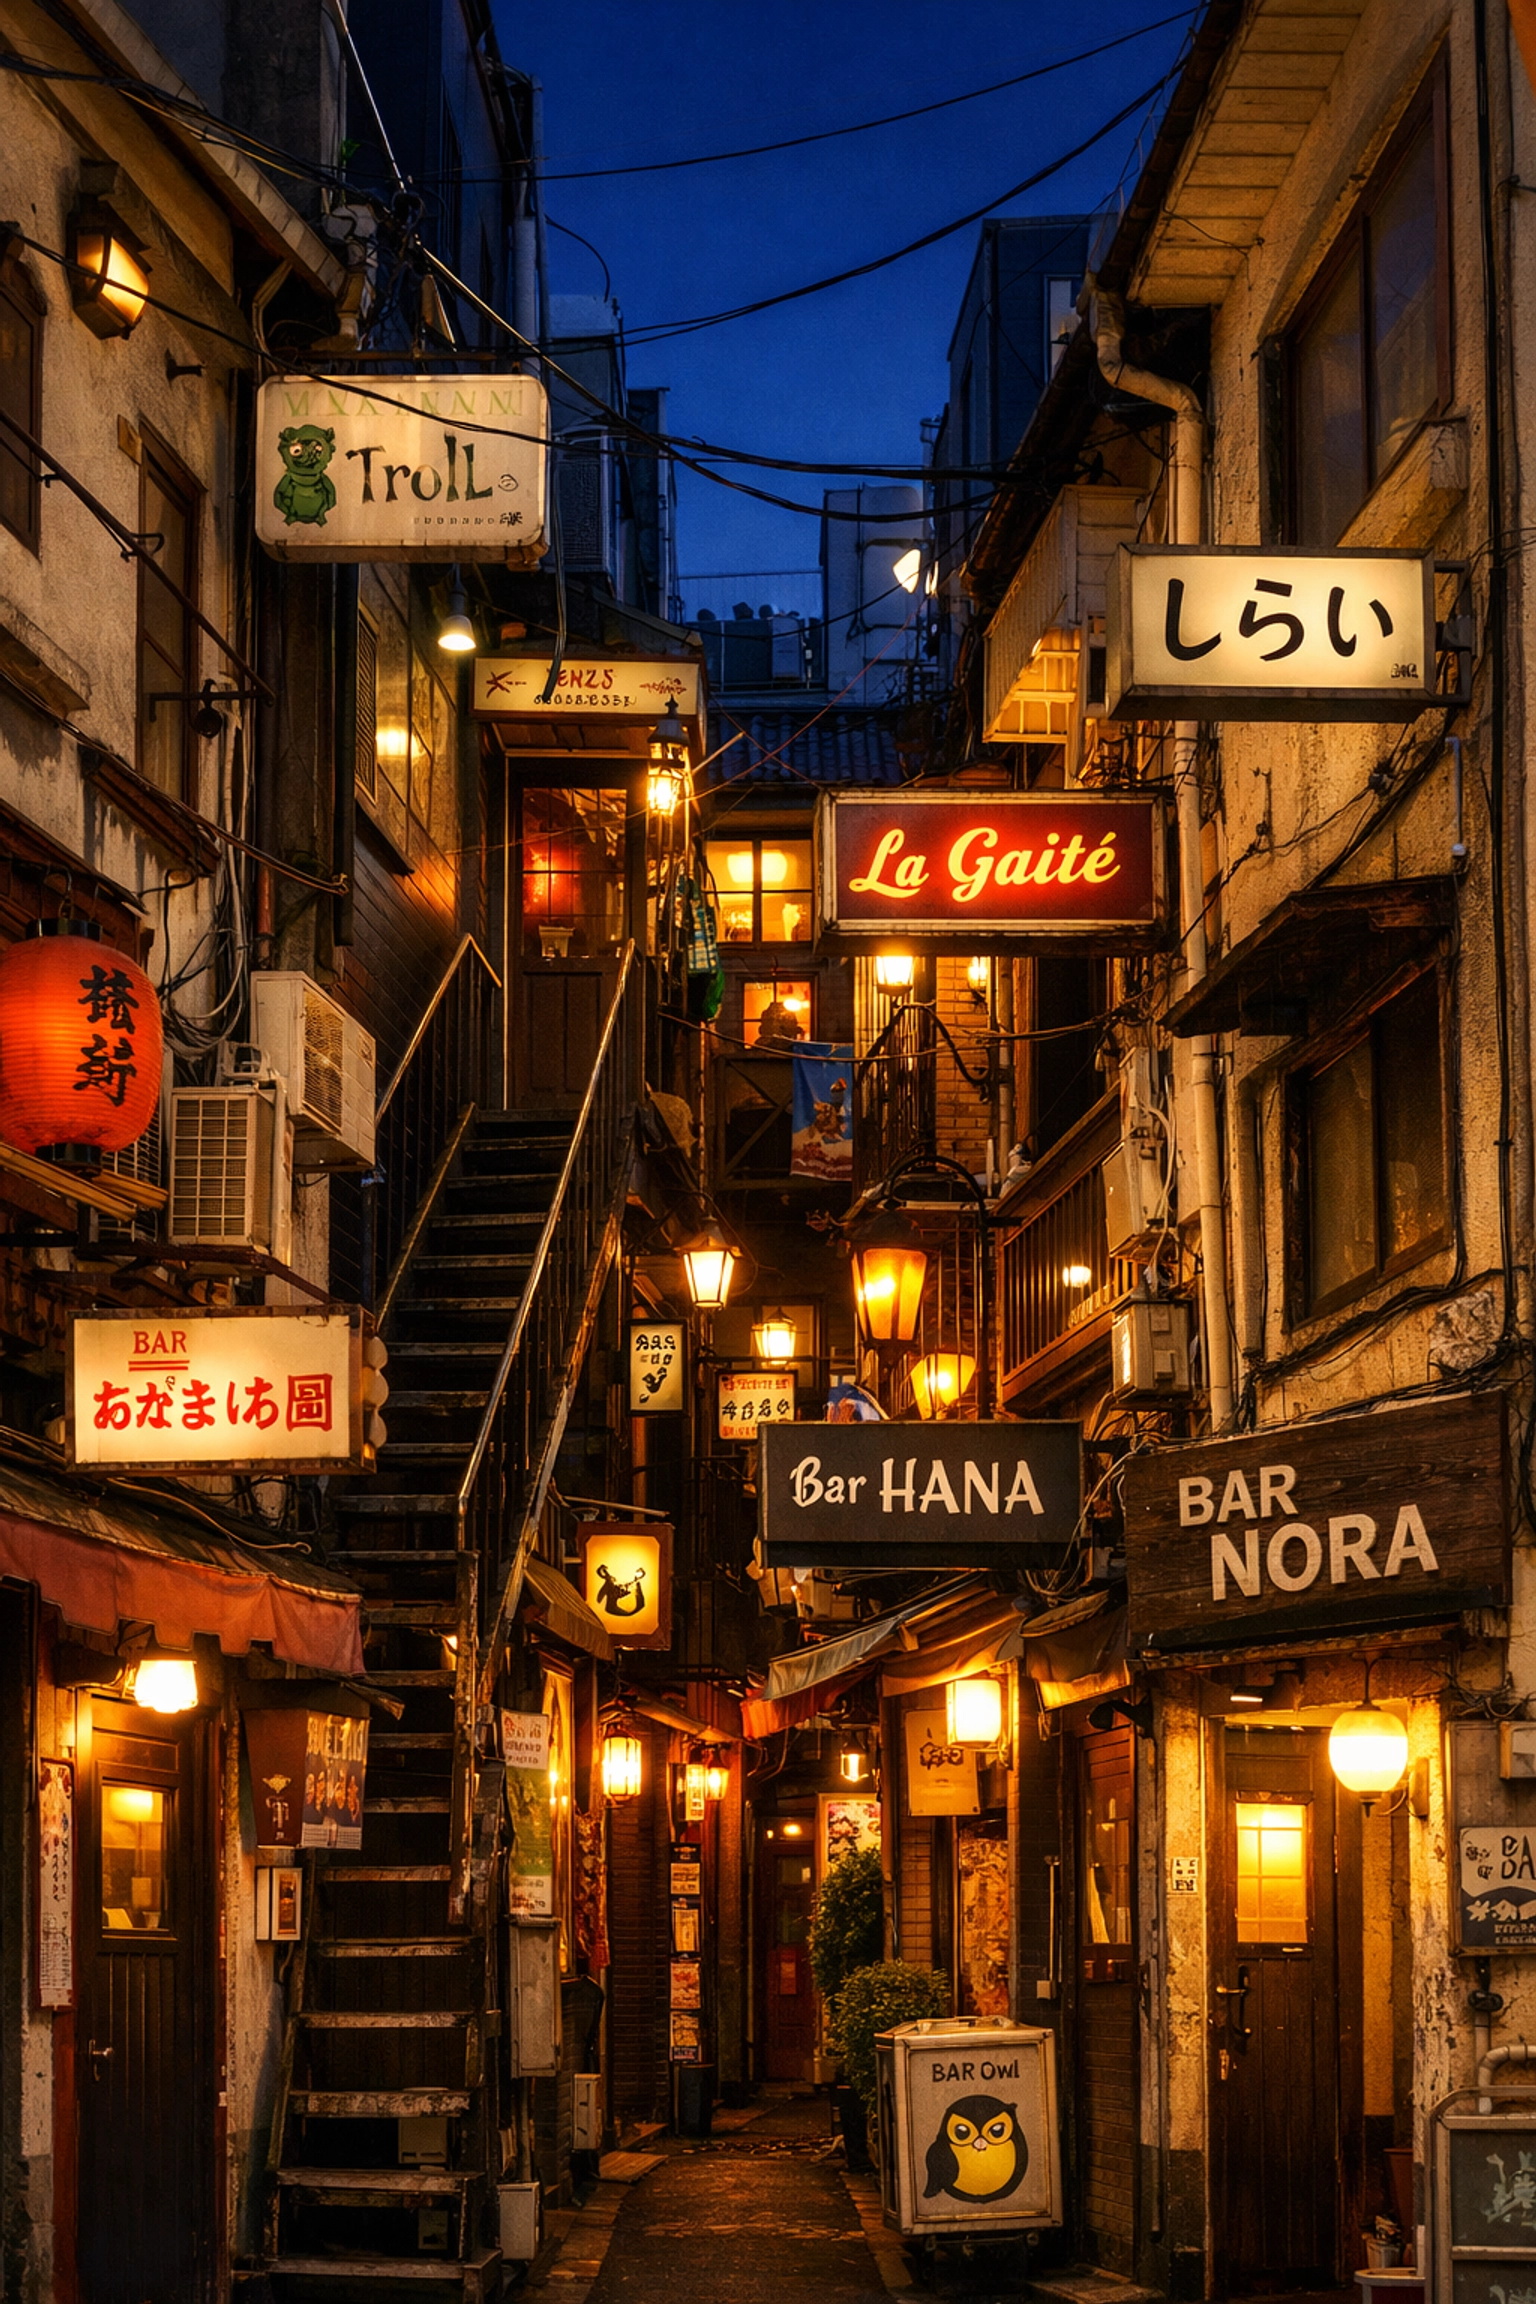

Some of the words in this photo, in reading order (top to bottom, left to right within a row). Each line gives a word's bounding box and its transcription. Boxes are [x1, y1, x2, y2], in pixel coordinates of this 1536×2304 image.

[1165, 578, 1394, 662] しらい
[849, 829, 929, 898] La
[948, 827, 1121, 903] Gaité
[133, 1330, 187, 1355] BAR
[789, 1456, 867, 1508] Bar
[879, 1458, 1045, 1515] HANA
[1178, 1464, 1299, 1527] BAR
[1211, 1504, 1440, 1601] NORA
[932, 2063, 975, 2083] BAR
[980, 2060, 1020, 2080] Owl
